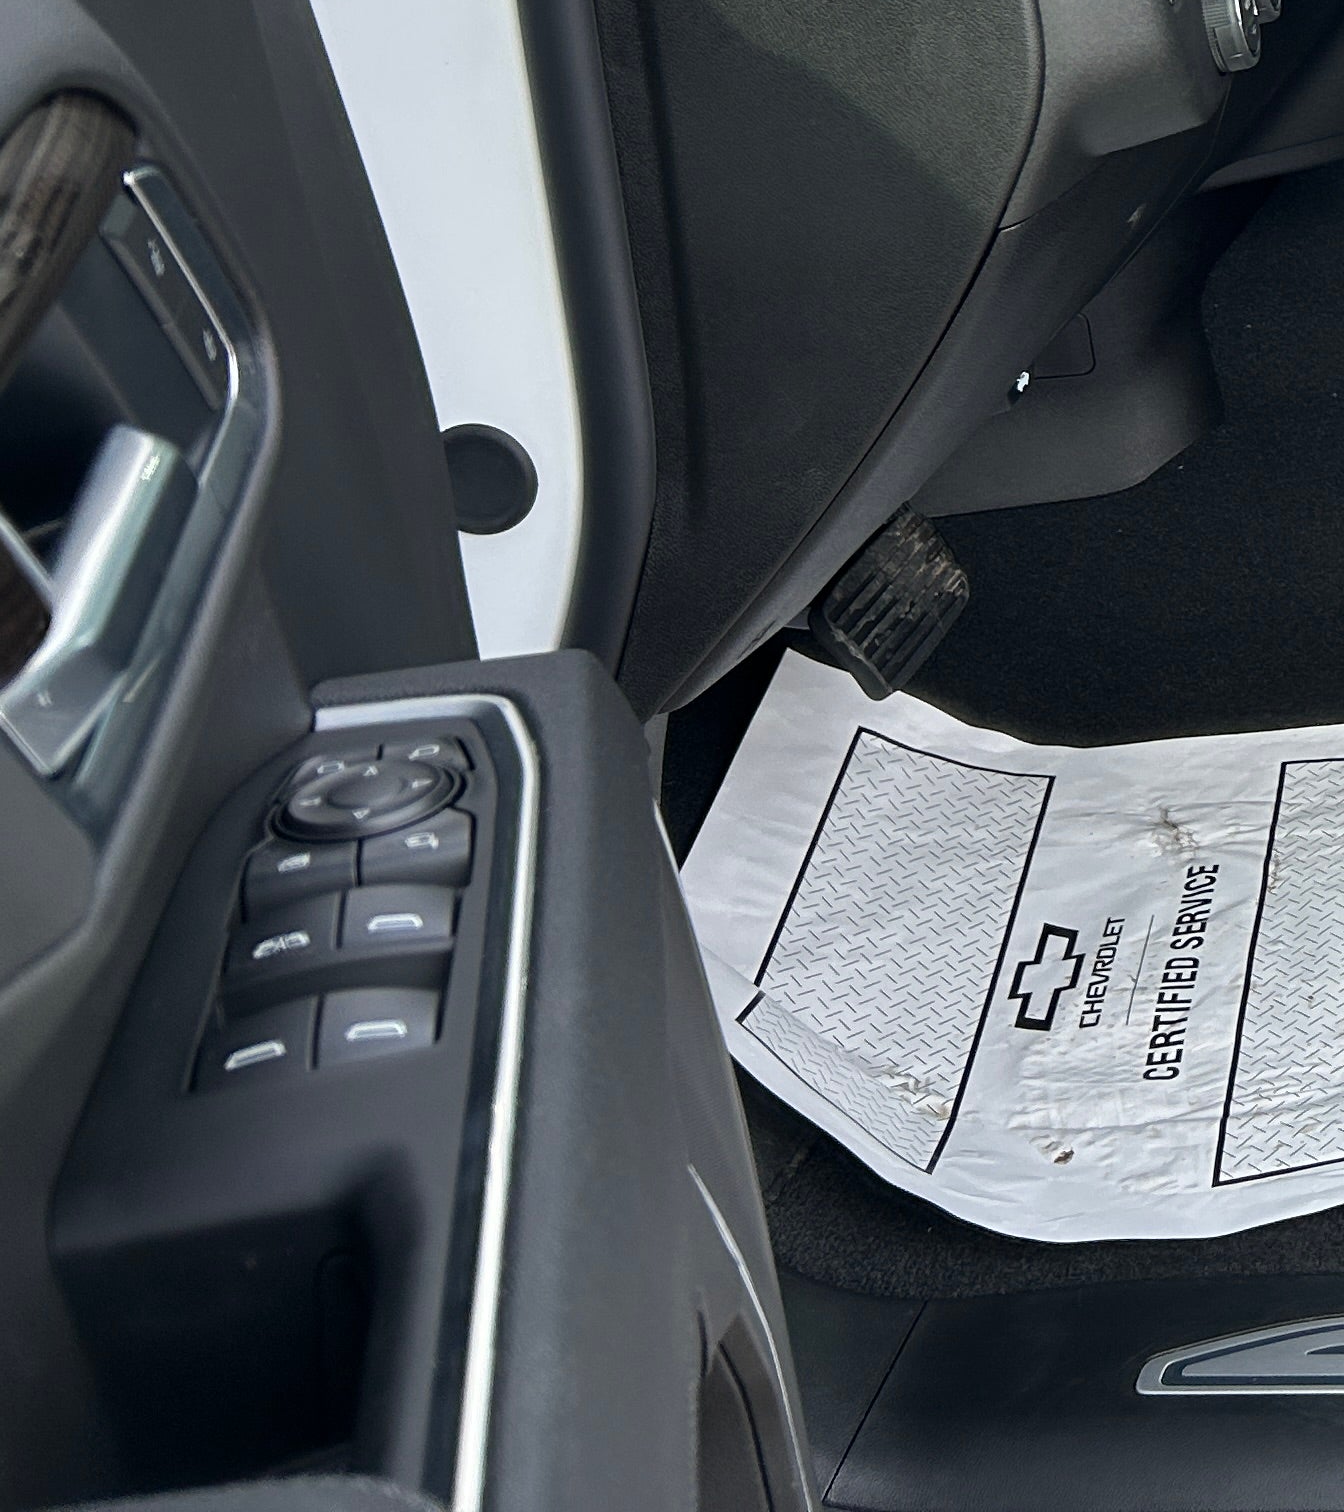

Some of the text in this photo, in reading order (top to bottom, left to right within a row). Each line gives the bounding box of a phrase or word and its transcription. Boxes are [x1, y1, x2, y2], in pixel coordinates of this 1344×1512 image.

[1079, 917, 1125, 1028] CHEVROLET
[1143, 864, 1220, 1081] CERTIFIED SERVICE
